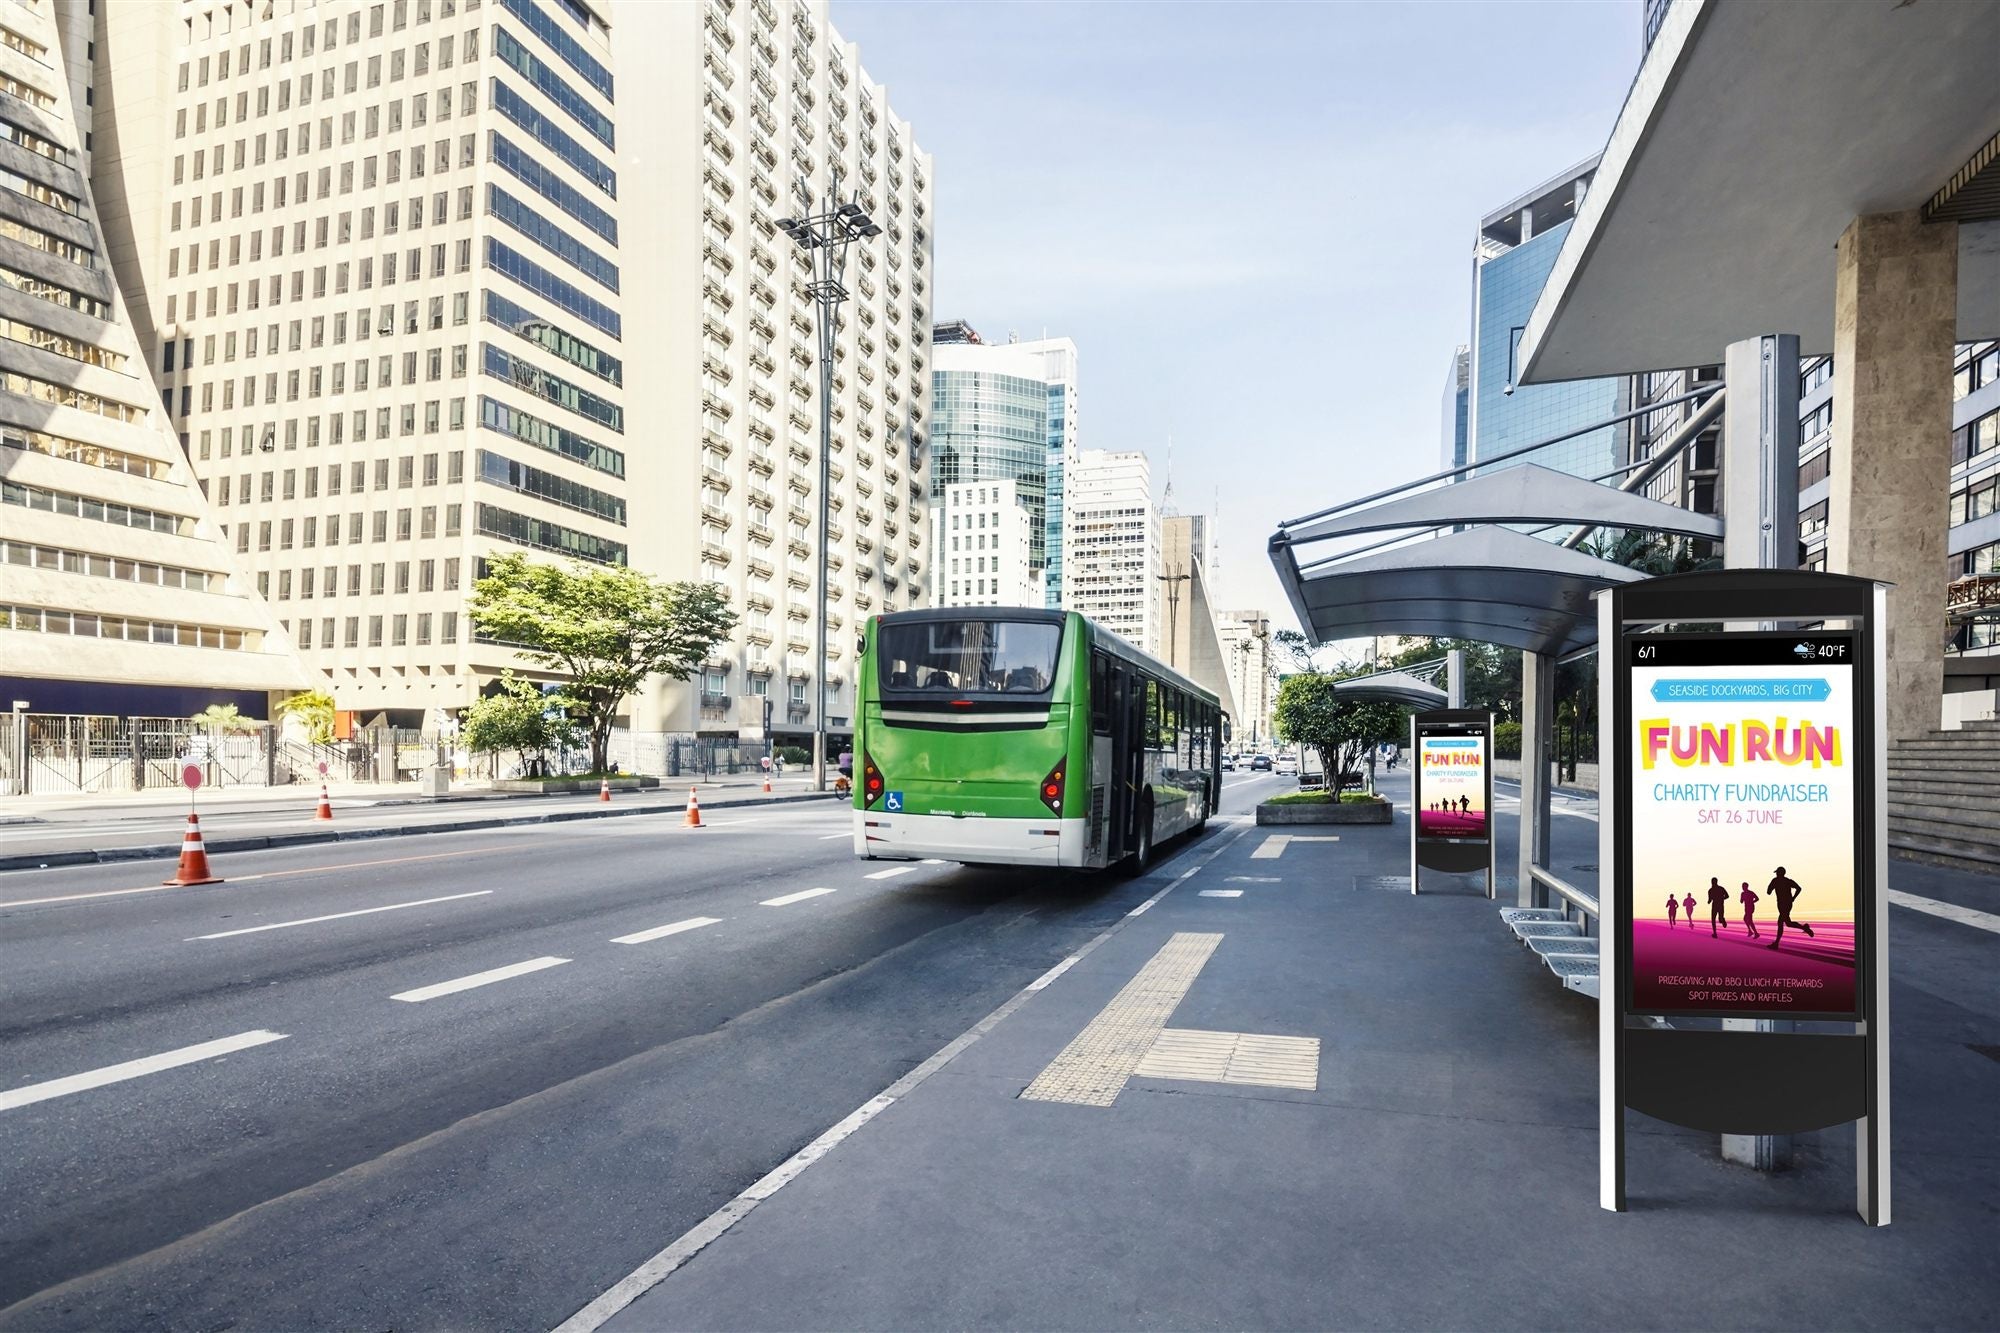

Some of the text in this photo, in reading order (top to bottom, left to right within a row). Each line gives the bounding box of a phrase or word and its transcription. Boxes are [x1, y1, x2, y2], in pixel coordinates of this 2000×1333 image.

[1638, 646, 1656, 659] 6/1
[1818, 645, 1846, 658] 40°F
[1668, 683, 1813, 697] SEASIDE DOCKYARDS, BIG CITY
[1644, 720, 1837, 767] FUN RUN
[1424, 753, 1480, 766] FUN RUN
[1653, 783, 1829, 802] CHARITY FUNDRAISER
[1698, 809, 1783, 824] SAT 26 JUNE
[1658, 976, 1823, 988] PRIZEGIVING AND BBQ LUNCH AFTERWARDS
[1688, 991, 1793, 1003] SPOT PRIZES AND RAFFLES
